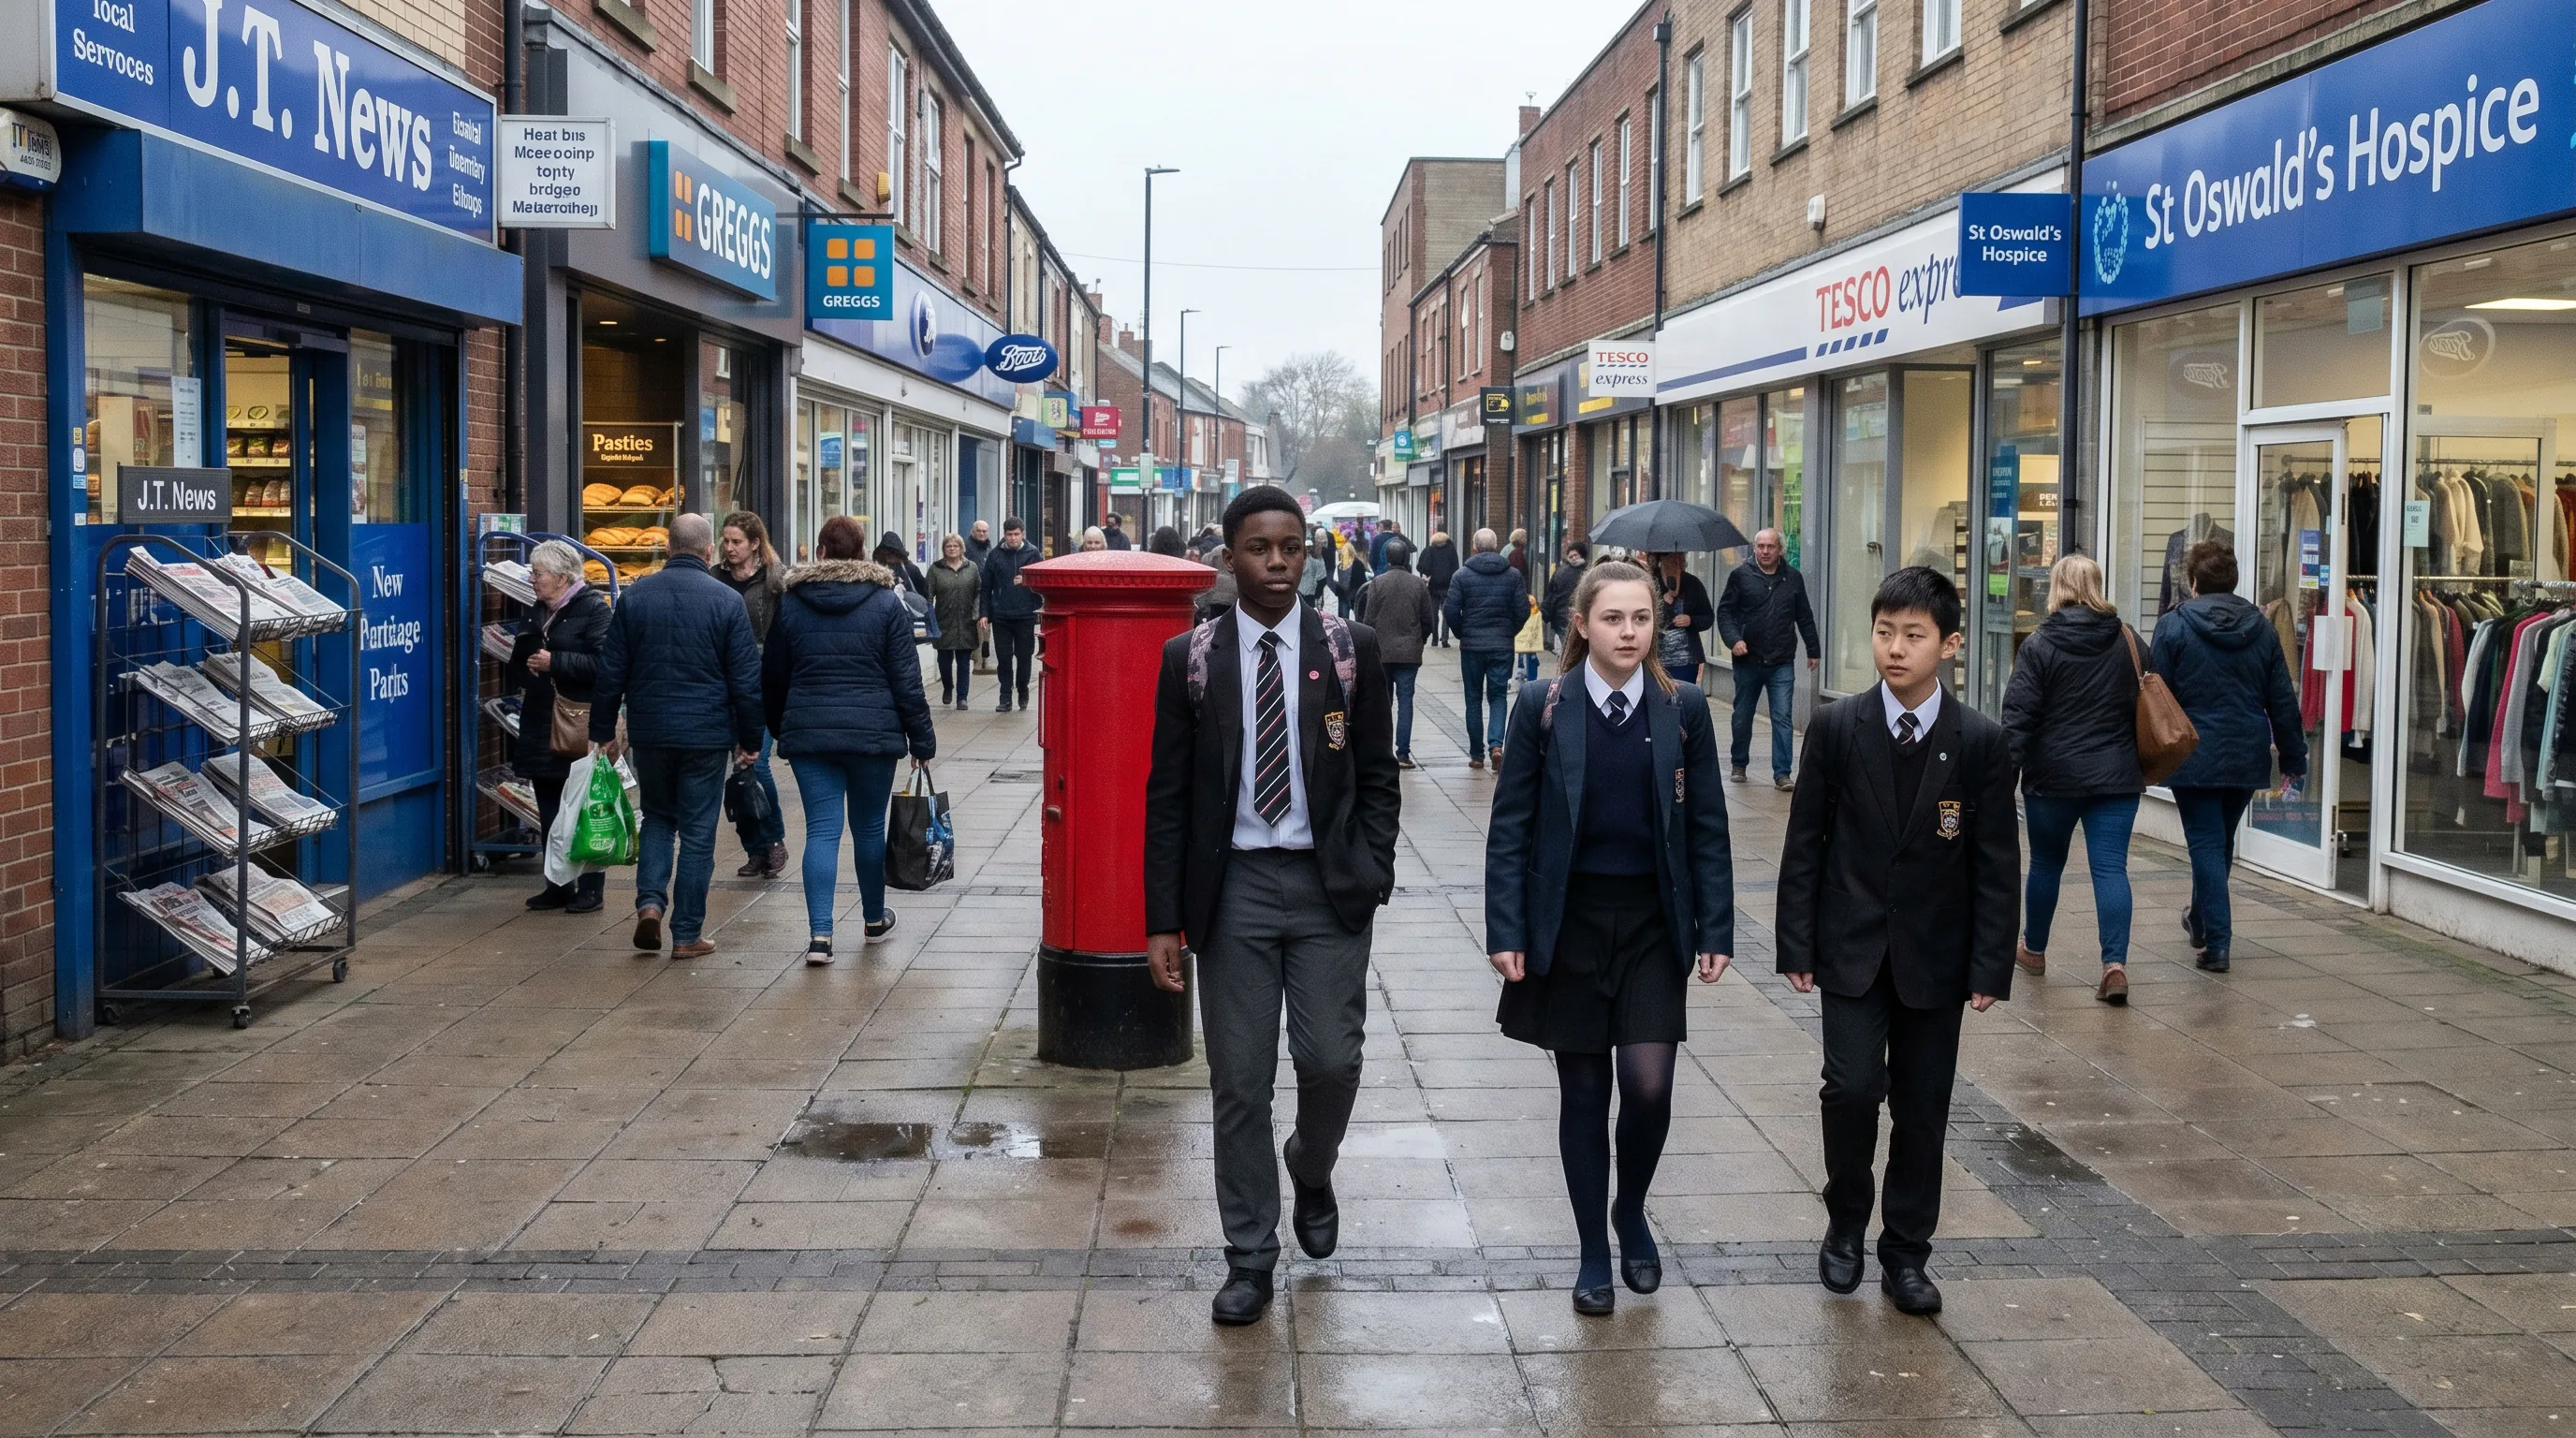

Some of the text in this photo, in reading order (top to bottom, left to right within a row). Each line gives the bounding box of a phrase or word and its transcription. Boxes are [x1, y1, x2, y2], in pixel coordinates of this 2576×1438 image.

[73, 28, 154, 85] Servoces
[183, 0, 432, 191] J.T. News
[524, 127, 557, 140] Heat
[2145, 74, 2539, 249] St Oswald's Hospice
[697, 183, 771, 279] GREGGS
[1969, 224, 2061, 242] St Oswald's
[1983, 246, 2047, 266] Hospice
[823, 295, 881, 308] GREGGS
[1816, 266, 1891, 332] TESCO
[996, 345, 1046, 372] Boots
[1596, 352, 1648, 363] TESCO
[1596, 374, 1647, 388] express
[593, 433, 653, 451] Pasties
[138, 479, 216, 510] J.T. News
[373, 565, 403, 598] New
